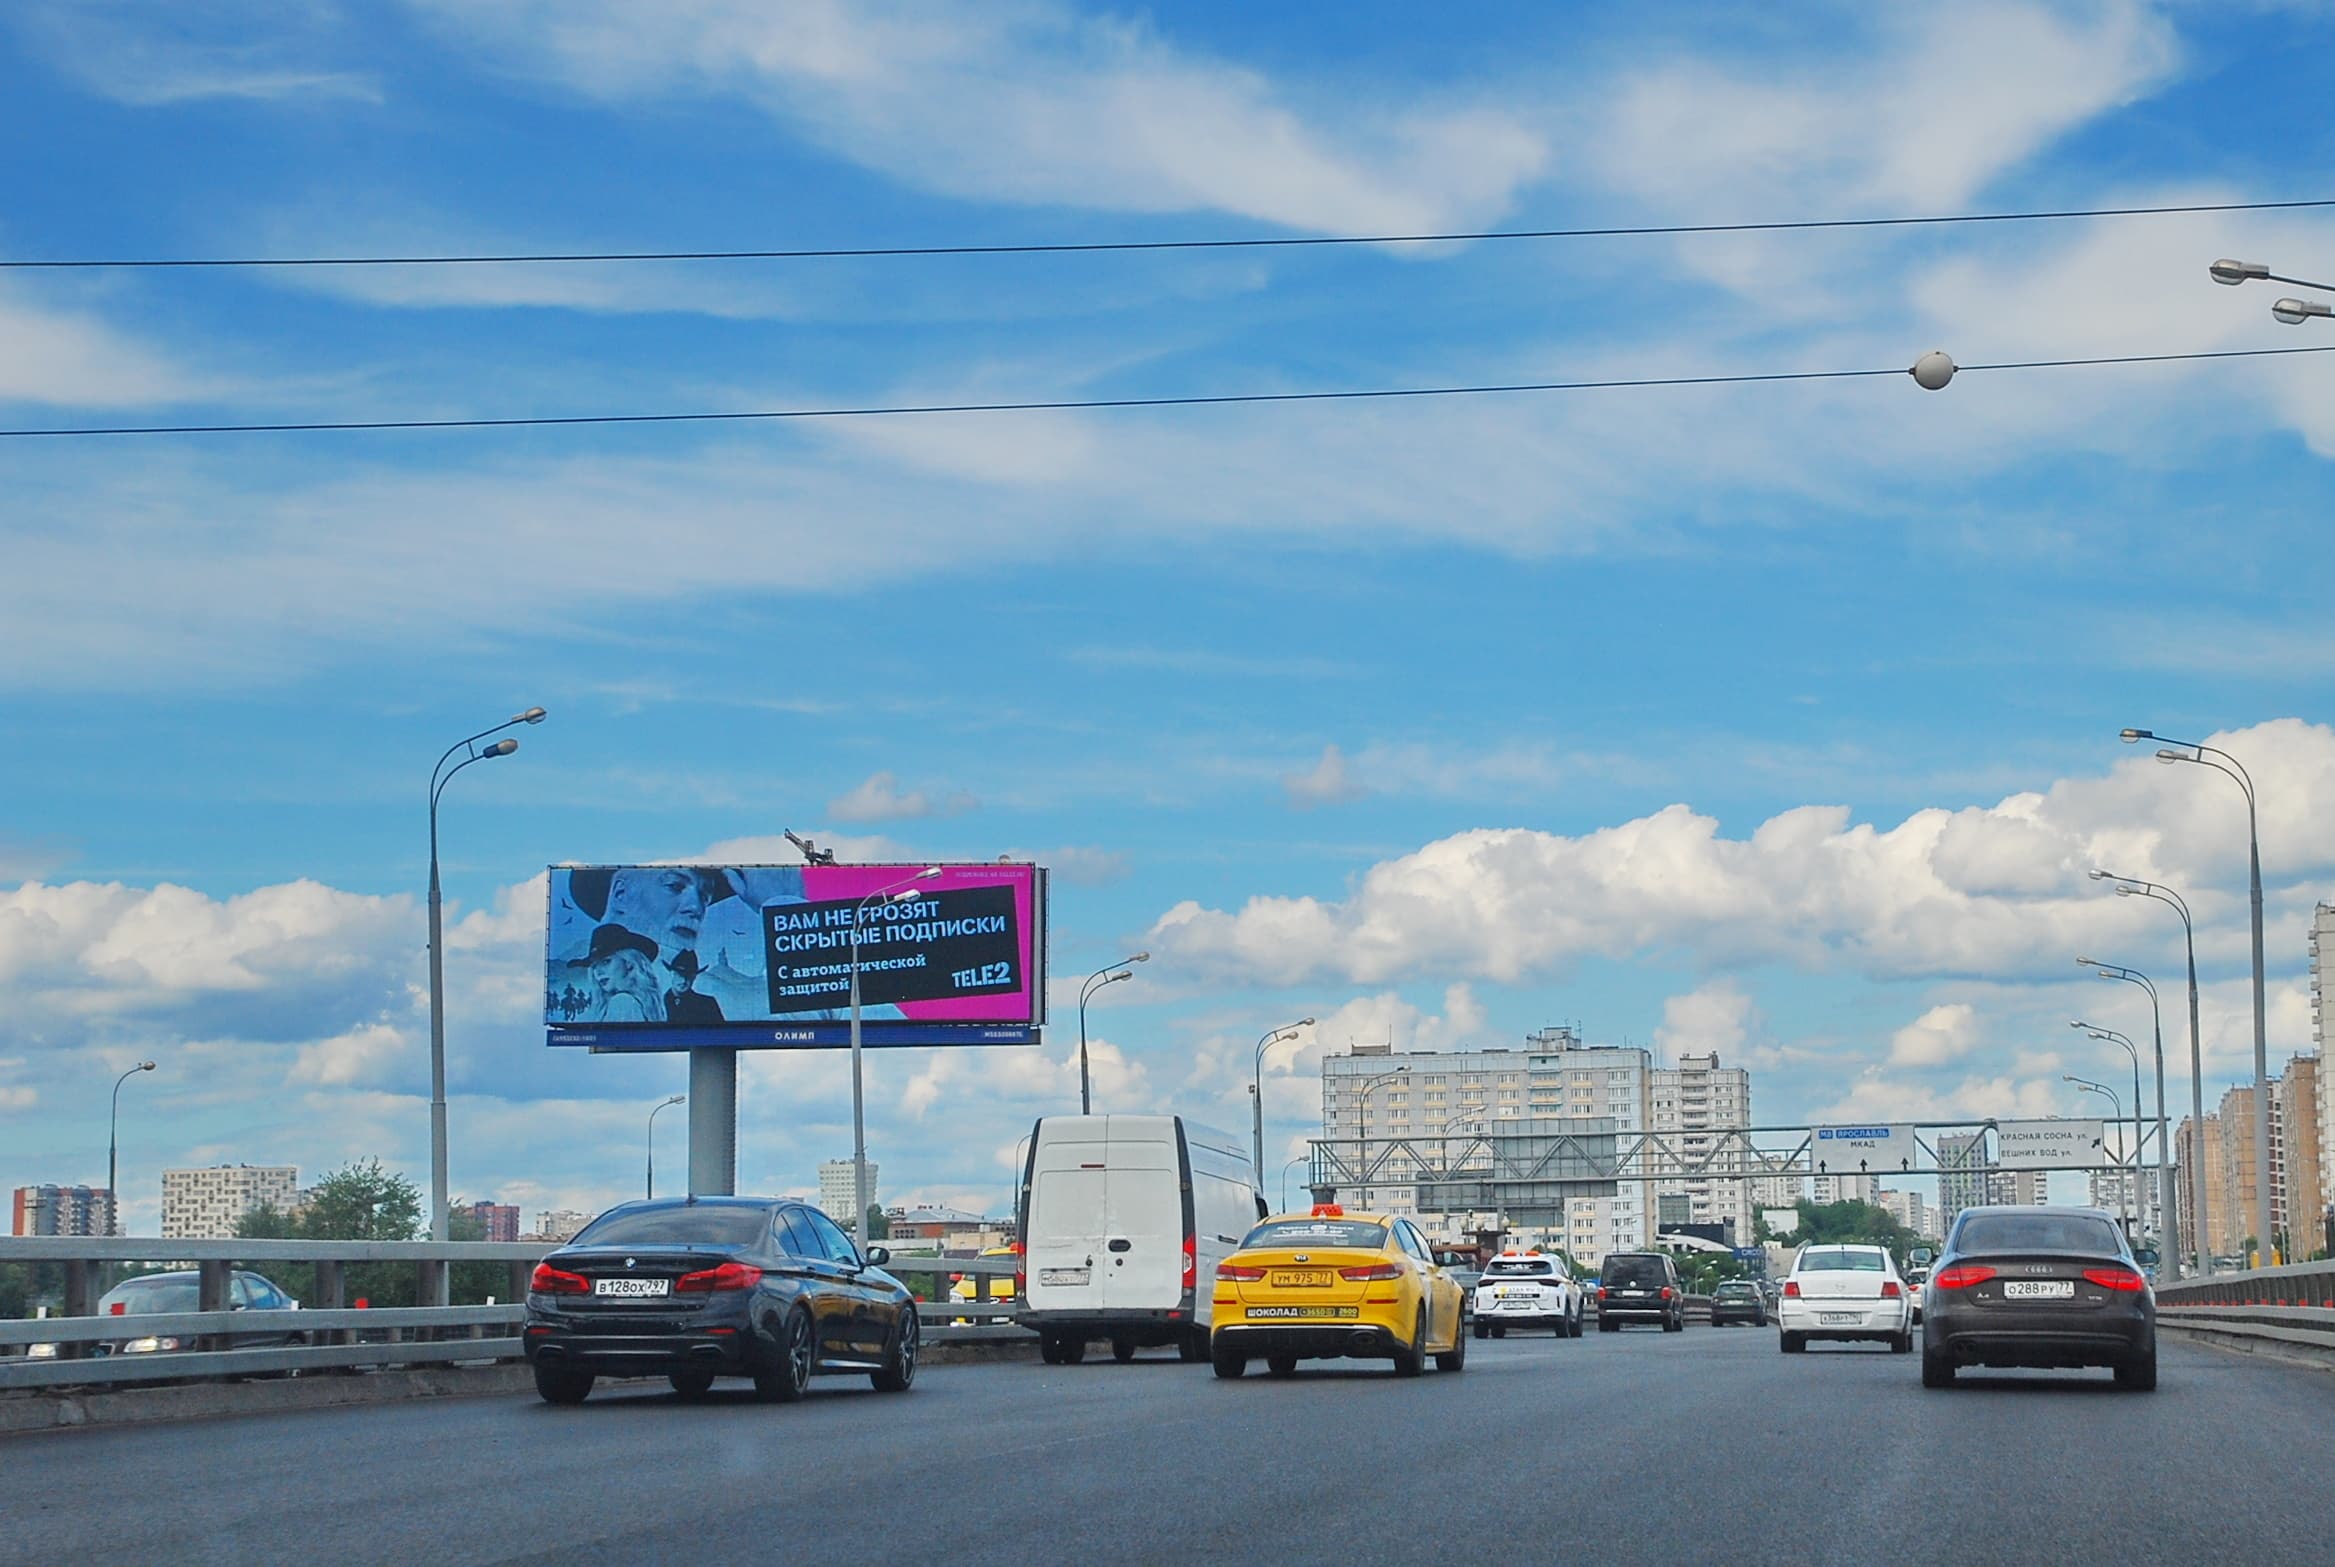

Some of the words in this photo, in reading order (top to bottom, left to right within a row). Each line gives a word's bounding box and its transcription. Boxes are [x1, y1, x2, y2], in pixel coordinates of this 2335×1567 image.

[774, 911, 819, 932] ВАМ
[825, 907, 853, 926] НЕ
[859, 901, 940, 924] ГРОЗЯТ
[775, 929, 882, 952] СКРЫТЫЕ
[886, 915, 1006, 943] ПОДПИСКИ
[778, 964, 788, 980] С
[952, 961, 1012, 988] TELE2
[779, 977, 850, 997] защитой
[774, 1031, 815, 1041] ОЛИМП
[1837, 1129, 1889, 1138] ЯРОСЛАВЛЬ
[2000, 1133, 2041, 1141] КРАСНАЯ
[2043, 1132, 2073, 1140] СОСНА
[2001, 1150, 2036, 1158] ВЕШНИХ
[2039, 1149, 2058, 1157] ВОД
[1294, 1273, 1313, 1283] 975
[1247, 1308, 1298, 1317] ШОКОЛАД
